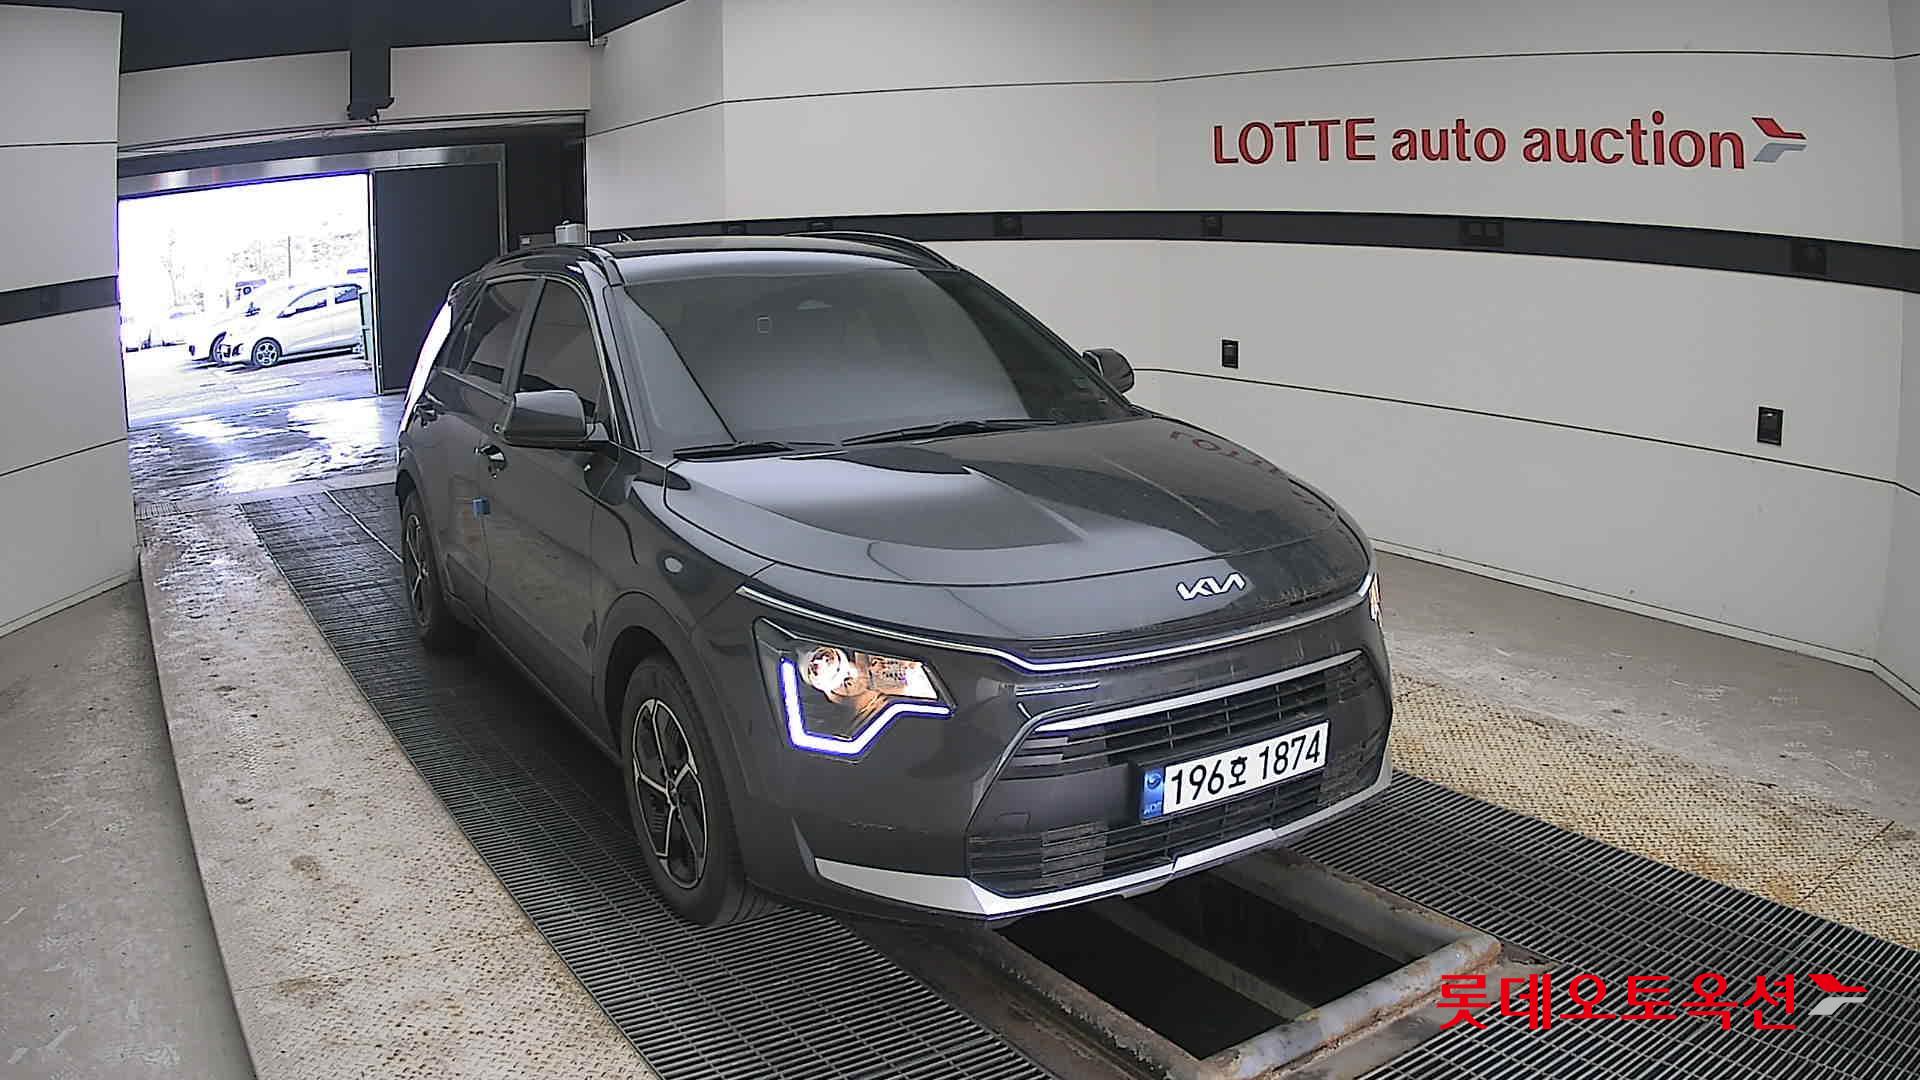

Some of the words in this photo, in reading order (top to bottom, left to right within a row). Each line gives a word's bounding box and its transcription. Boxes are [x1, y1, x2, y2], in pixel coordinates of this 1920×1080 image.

[1212, 117, 1376, 165] LOTTE
[1391, 118, 1507, 163] auto
[1522, 110, 1746, 171] auction
[1176, 572, 1246, 601] KIA
[1171, 756, 1248, 805] 196호
[1259, 730, 1320, 780] 1874
